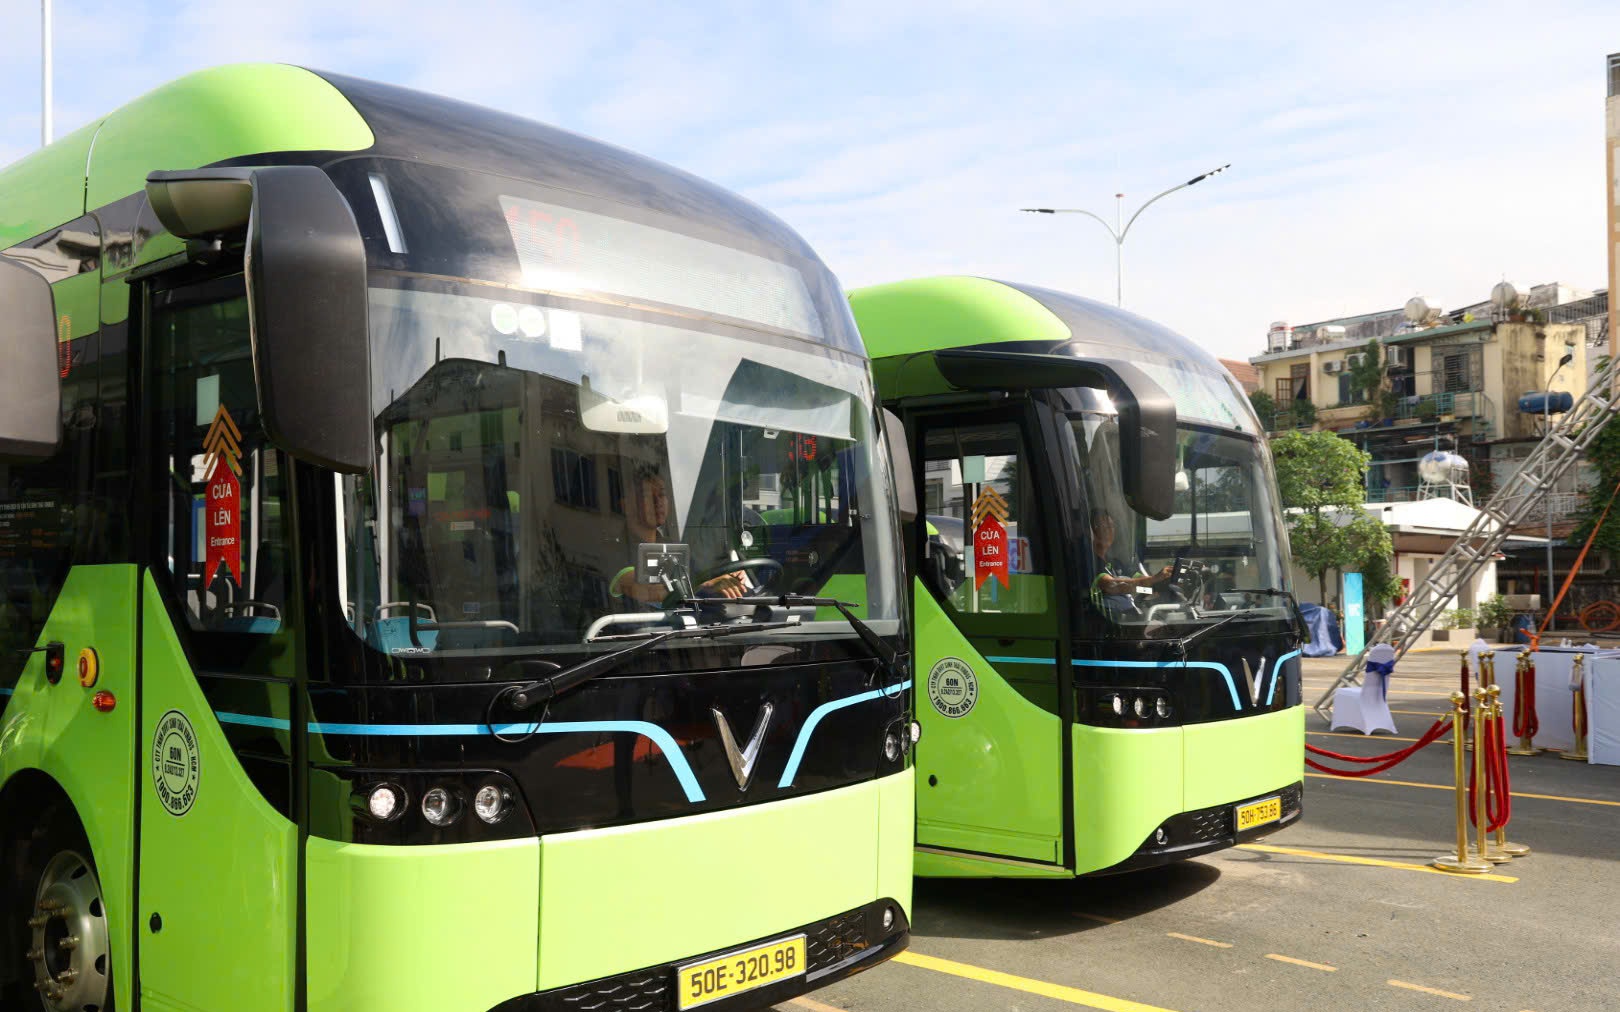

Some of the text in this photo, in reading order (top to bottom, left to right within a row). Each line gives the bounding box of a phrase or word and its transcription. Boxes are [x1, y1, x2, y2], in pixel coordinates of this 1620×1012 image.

[212, 478, 232, 499] CỬA
[214, 507, 231, 526] LÊN
[980, 528, 1000, 540] CỬA
[210, 537, 235, 547] Entrance
[982, 544, 999, 556] LÊN
[945, 678, 959, 687] 60N
[169, 746, 182, 761] 60N
[691, 946, 795, 998] 50E-320.98
